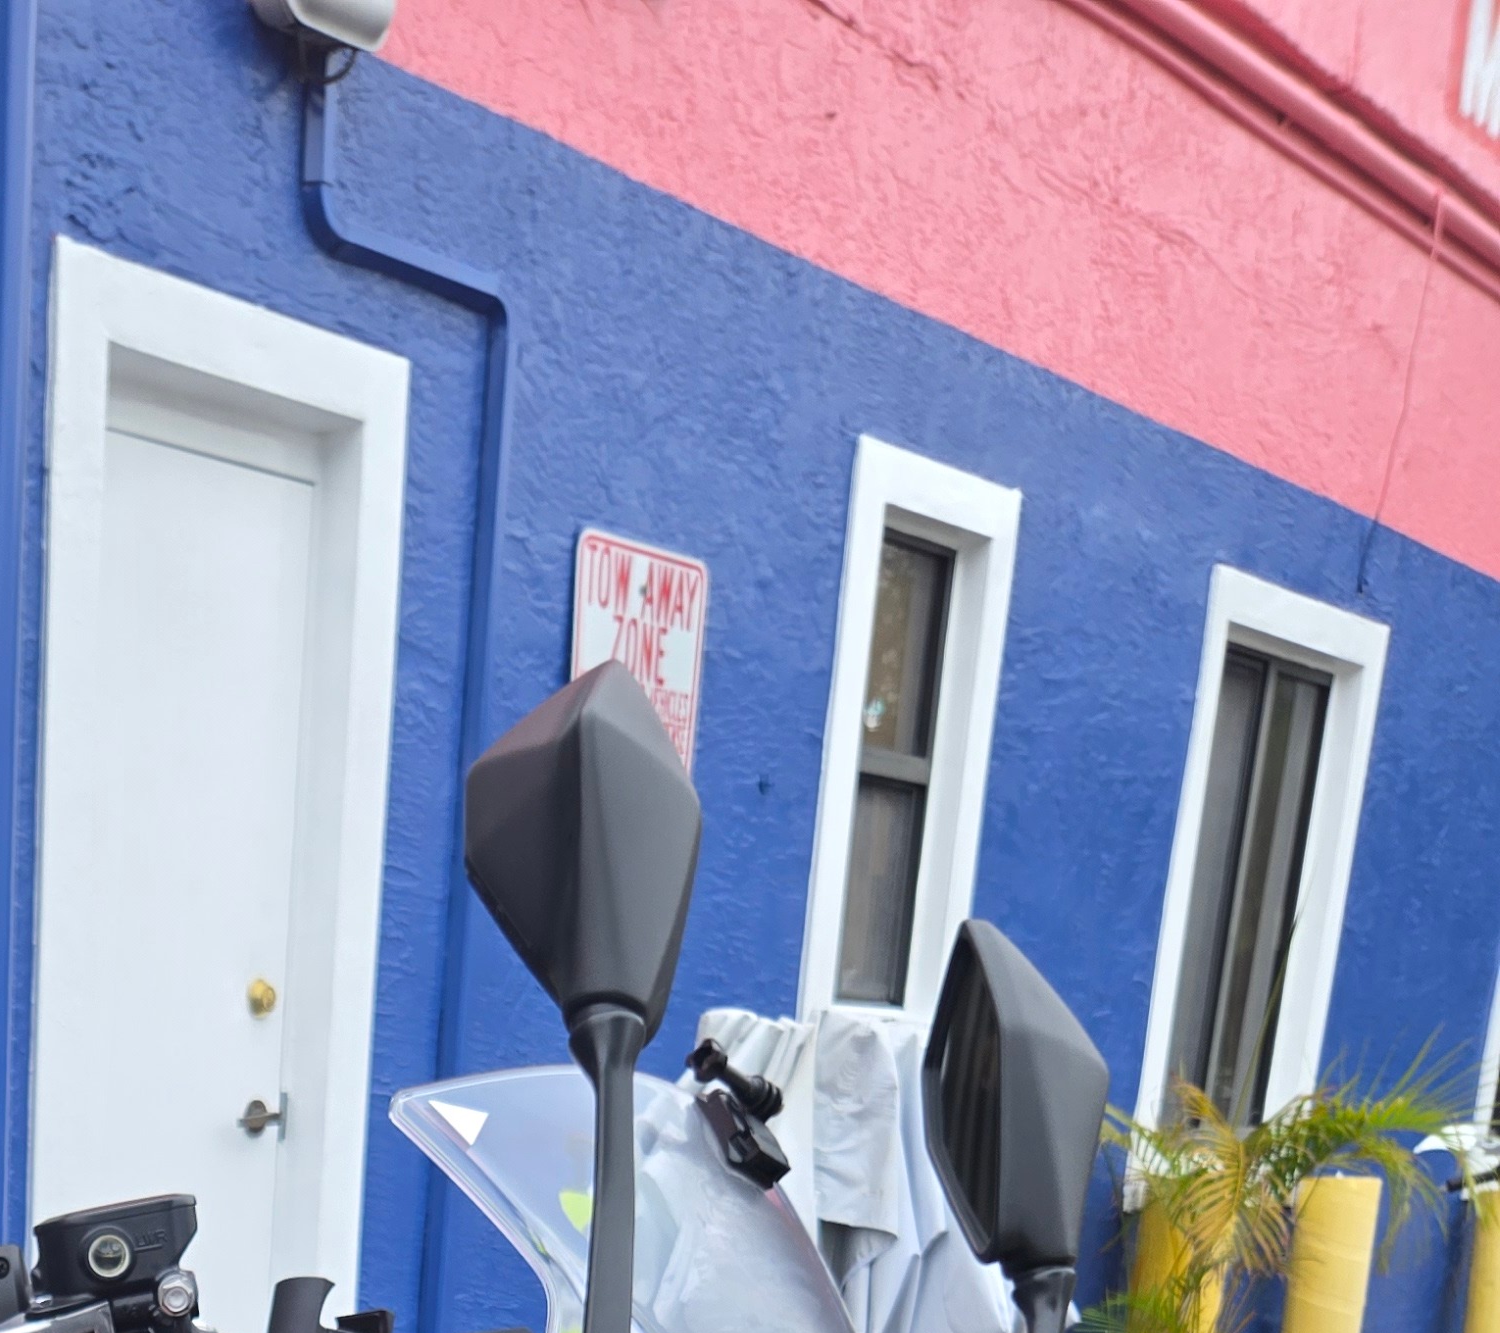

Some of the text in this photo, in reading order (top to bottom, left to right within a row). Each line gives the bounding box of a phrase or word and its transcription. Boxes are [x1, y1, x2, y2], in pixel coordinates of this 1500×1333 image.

[586, 541, 700, 632] TOW AWAY
[612, 615, 668, 687] ZONE
